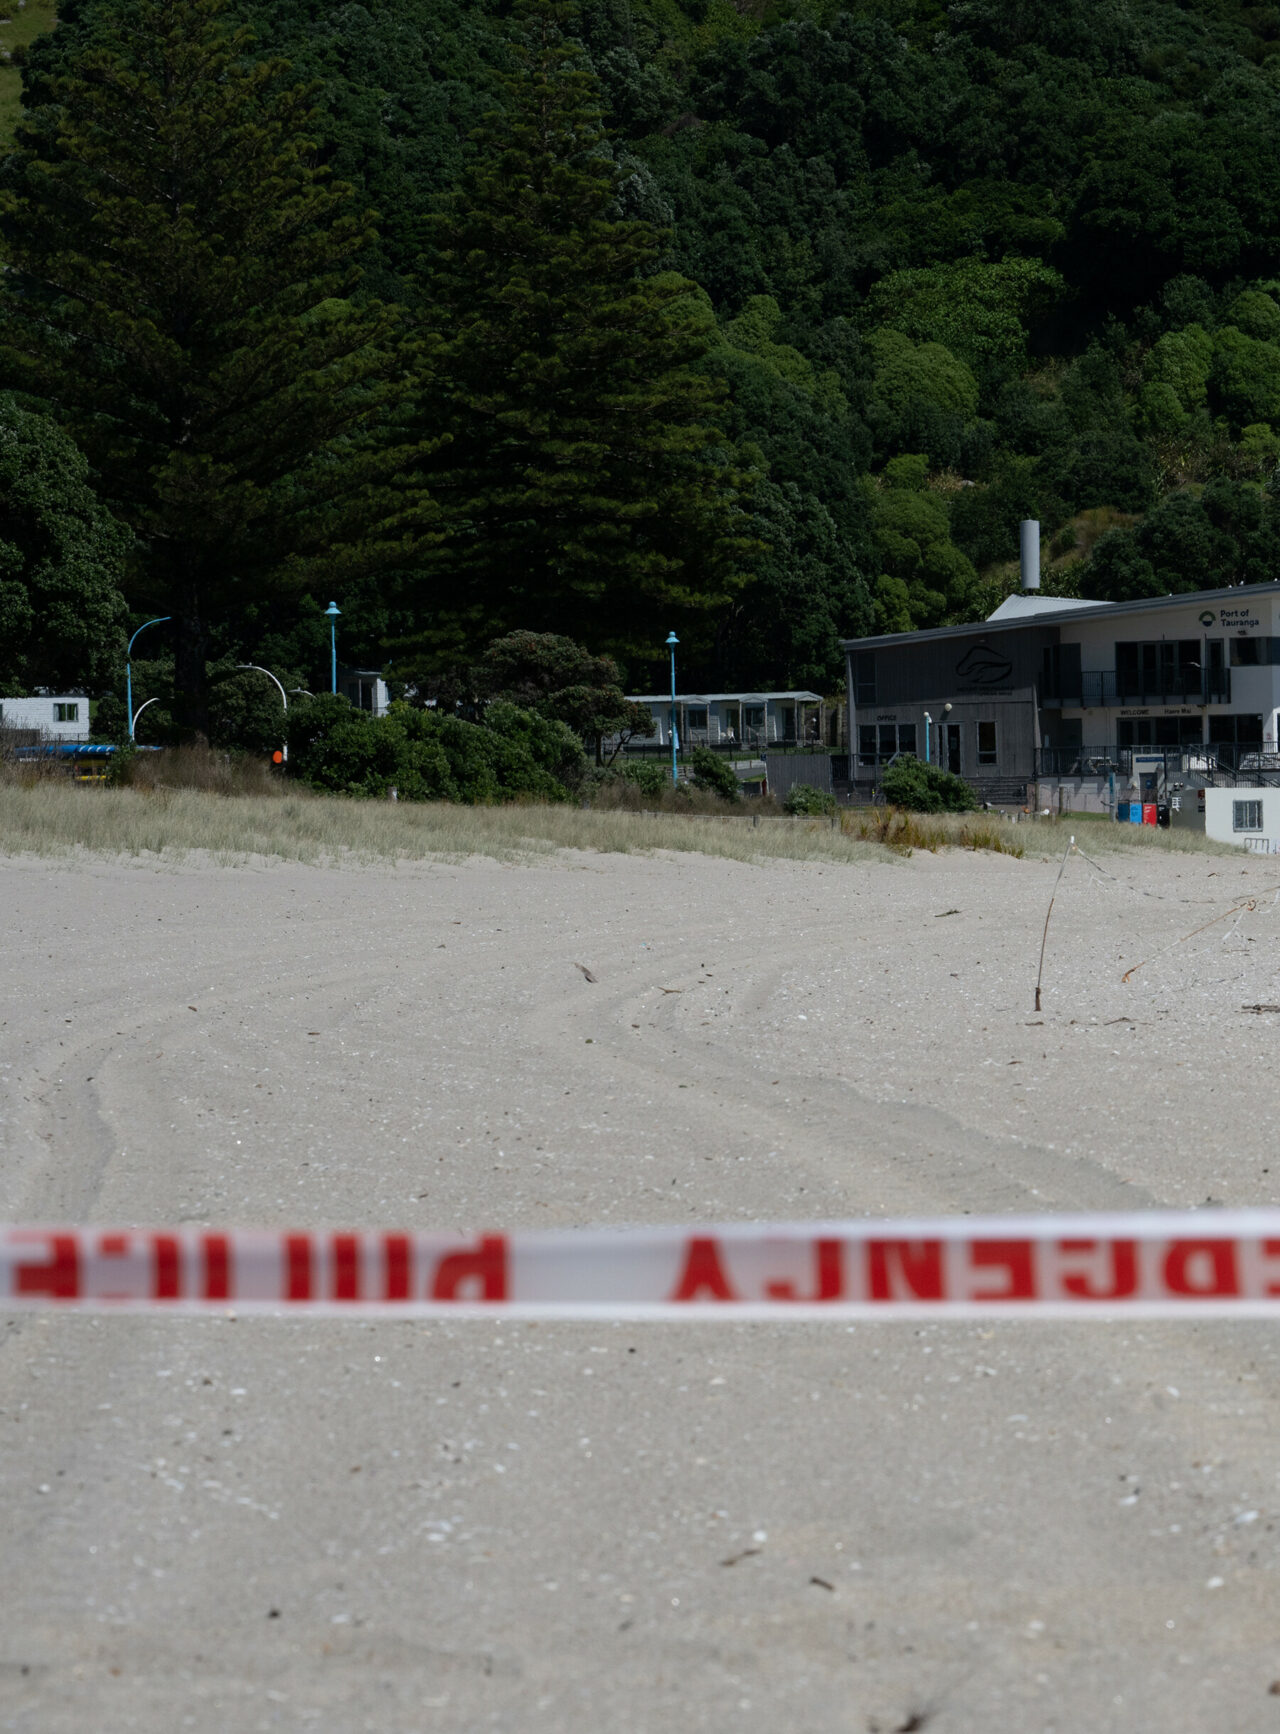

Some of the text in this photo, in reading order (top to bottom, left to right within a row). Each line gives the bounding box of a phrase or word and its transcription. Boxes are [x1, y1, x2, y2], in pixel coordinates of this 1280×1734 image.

[1220, 609, 1249, 618] Port of
[1221, 618, 1259, 628] Tauranga
